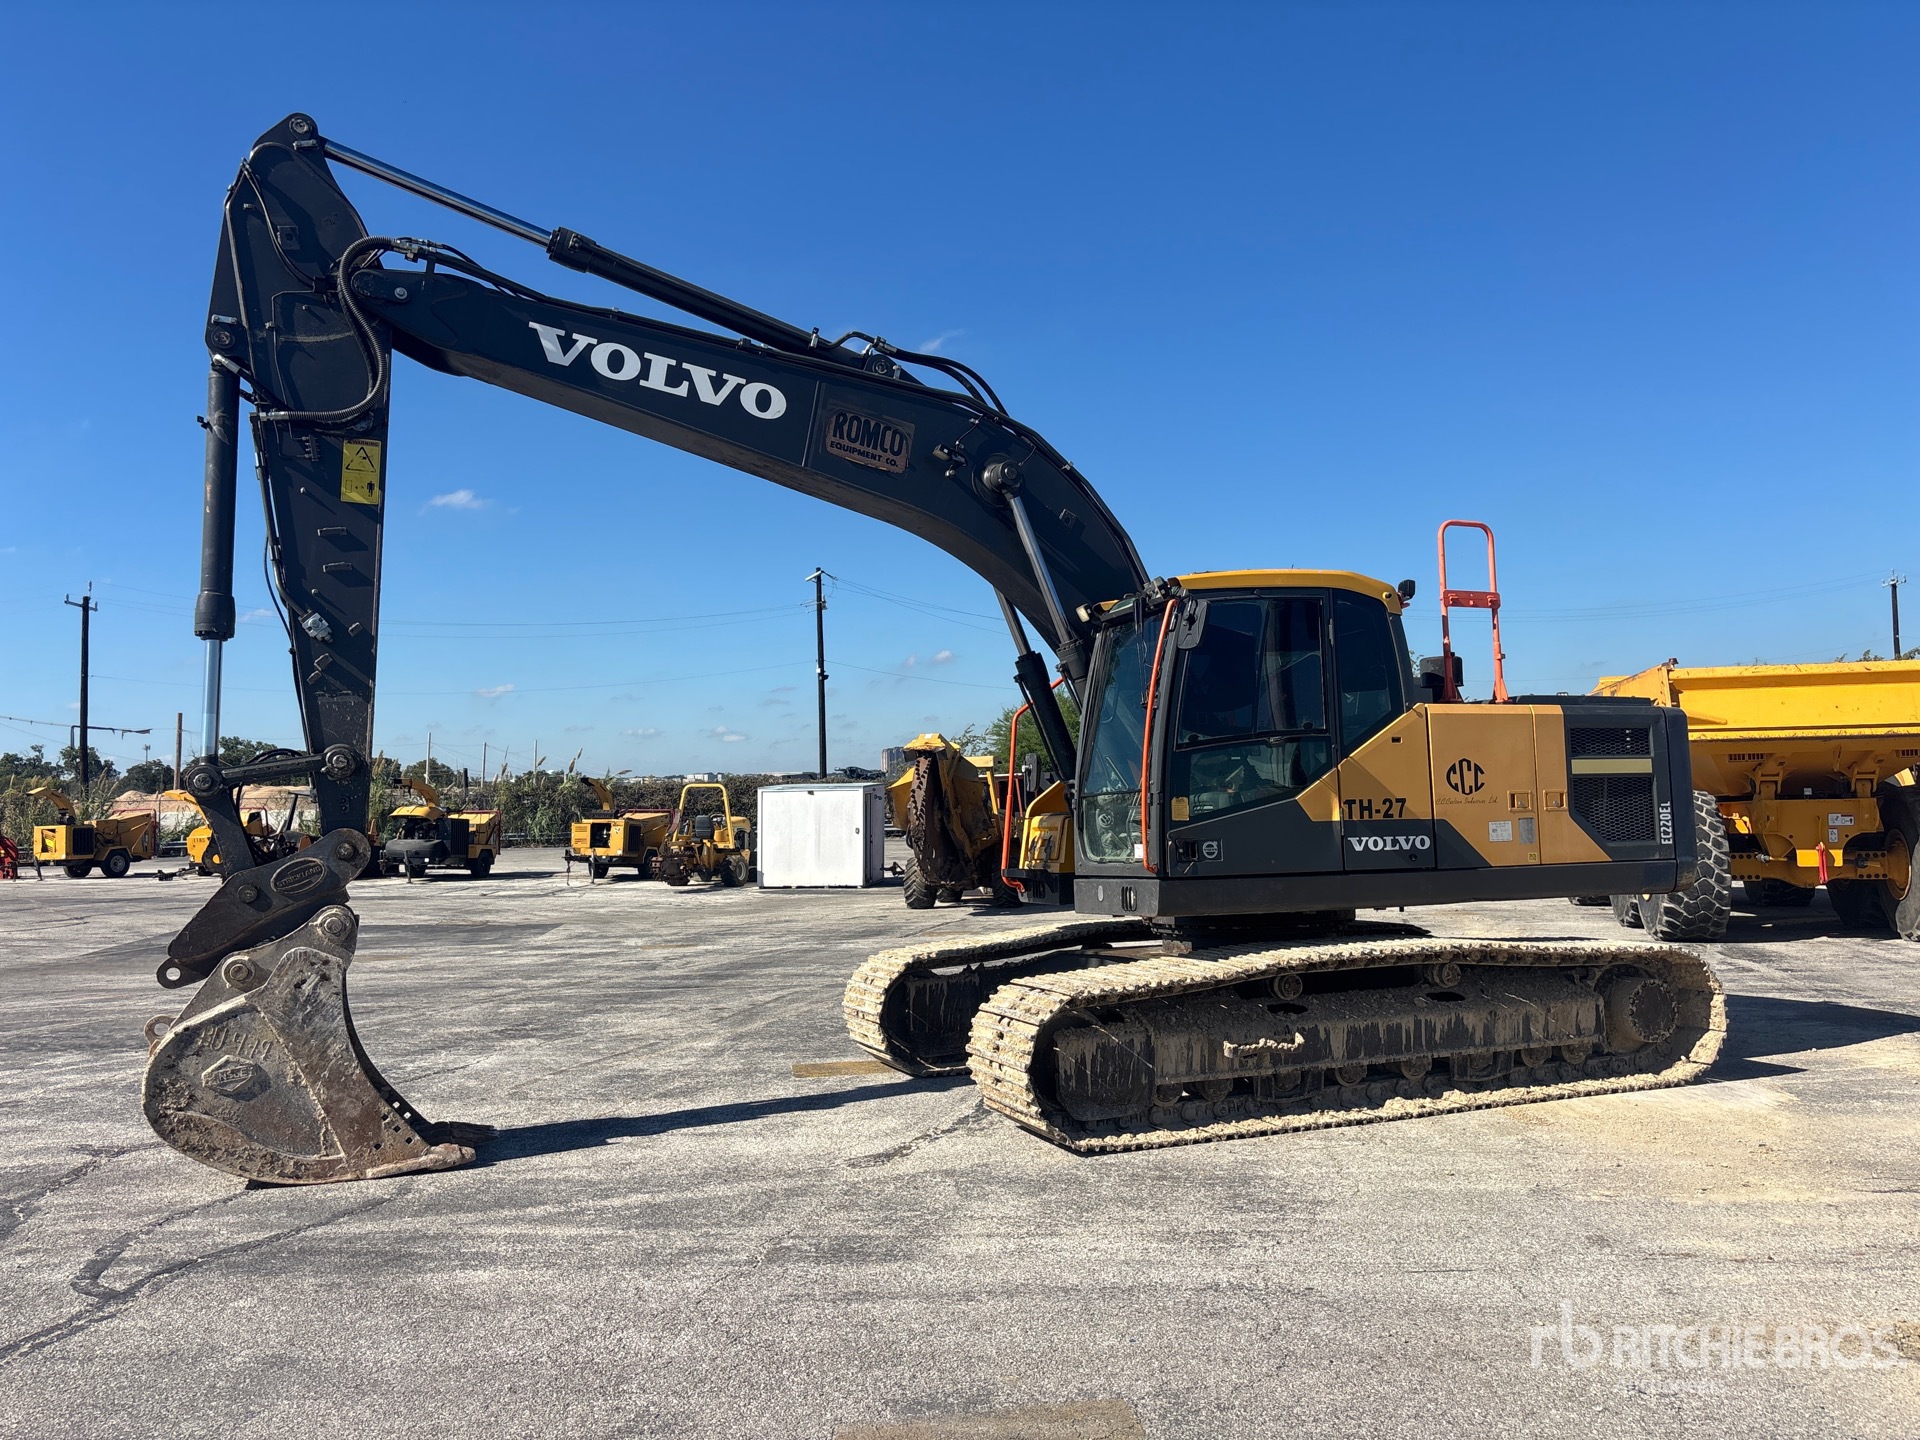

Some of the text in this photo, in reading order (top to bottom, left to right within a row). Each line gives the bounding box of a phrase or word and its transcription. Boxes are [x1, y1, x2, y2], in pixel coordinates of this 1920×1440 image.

[528, 321, 787, 420] VOLVO
[832, 411, 904, 457] ROMCO
[829, 440, 899, 468] EQUIPMENT CO.
[1445, 757, 1486, 796] CCC
[1343, 797, 1407, 820] TH-27
[1659, 800, 1673, 845] EC220EL
[1347, 835, 1431, 852] VOLVO
[276, 865, 321, 888] STRICKLAND
